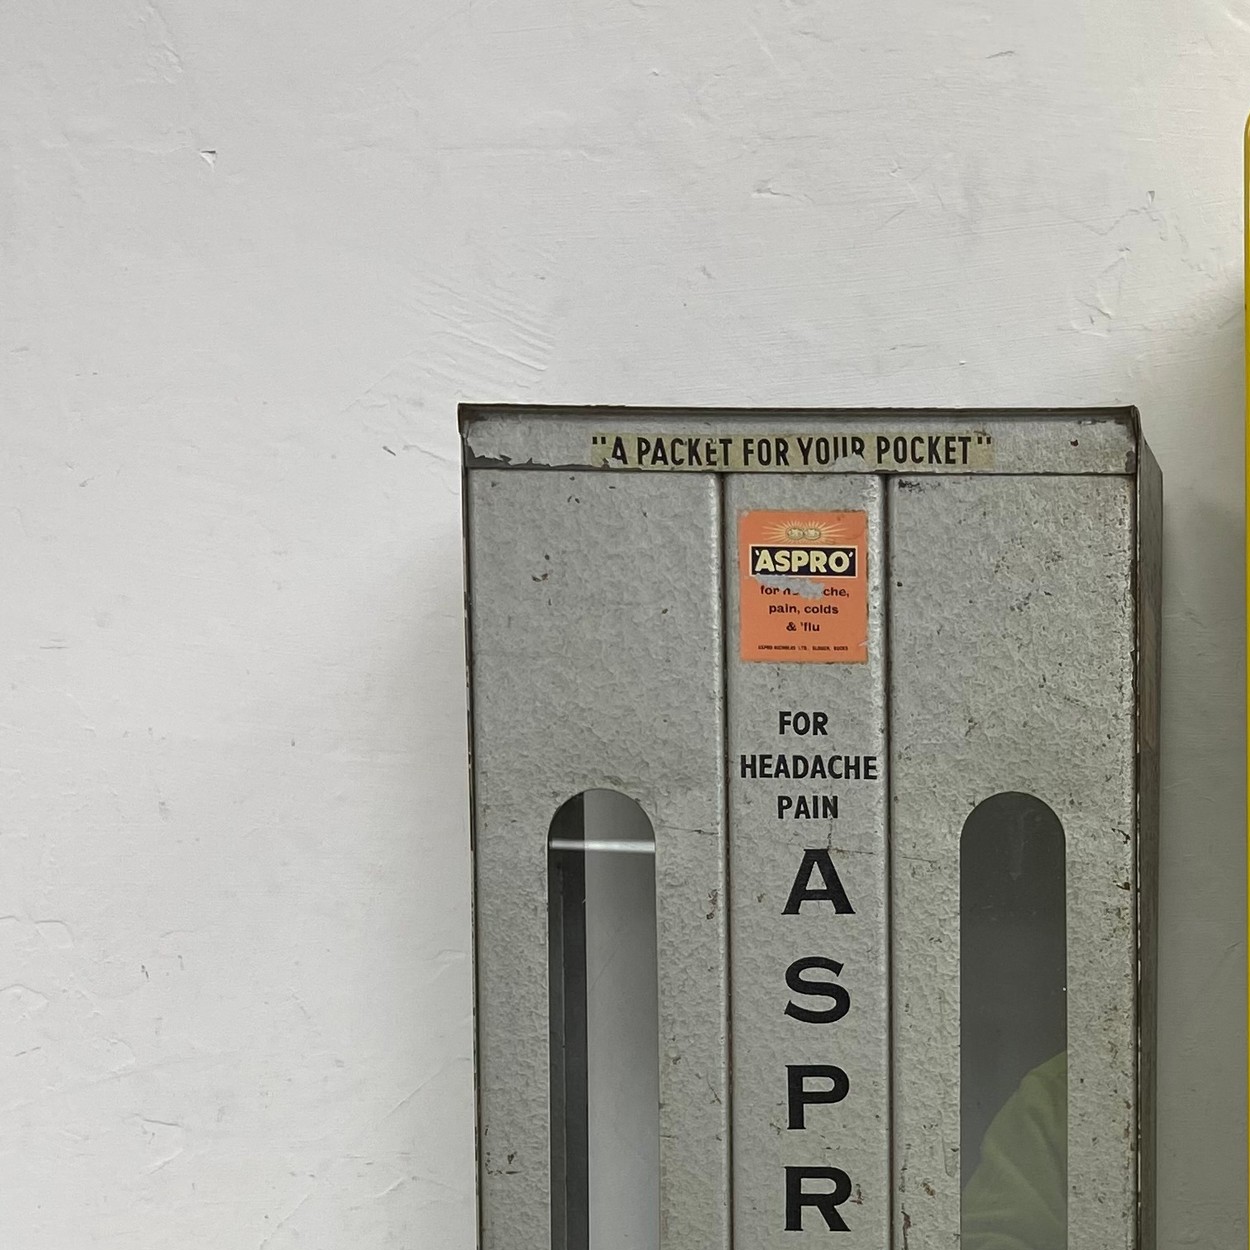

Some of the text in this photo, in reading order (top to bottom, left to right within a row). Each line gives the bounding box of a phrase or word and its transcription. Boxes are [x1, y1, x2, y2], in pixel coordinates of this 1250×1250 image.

[637, 437, 733, 466] PACKET
[743, 438, 789, 466] FOR
[797, 437, 865, 466] YOUR
[760, 584, 779, 595] for
[769, 603, 839, 615] pain, colds
[786, 621, 797, 632] &
[778, 711, 828, 736] FOR
[740, 754, 878, 780] HEADACHE
[777, 795, 839, 820] PAIN
